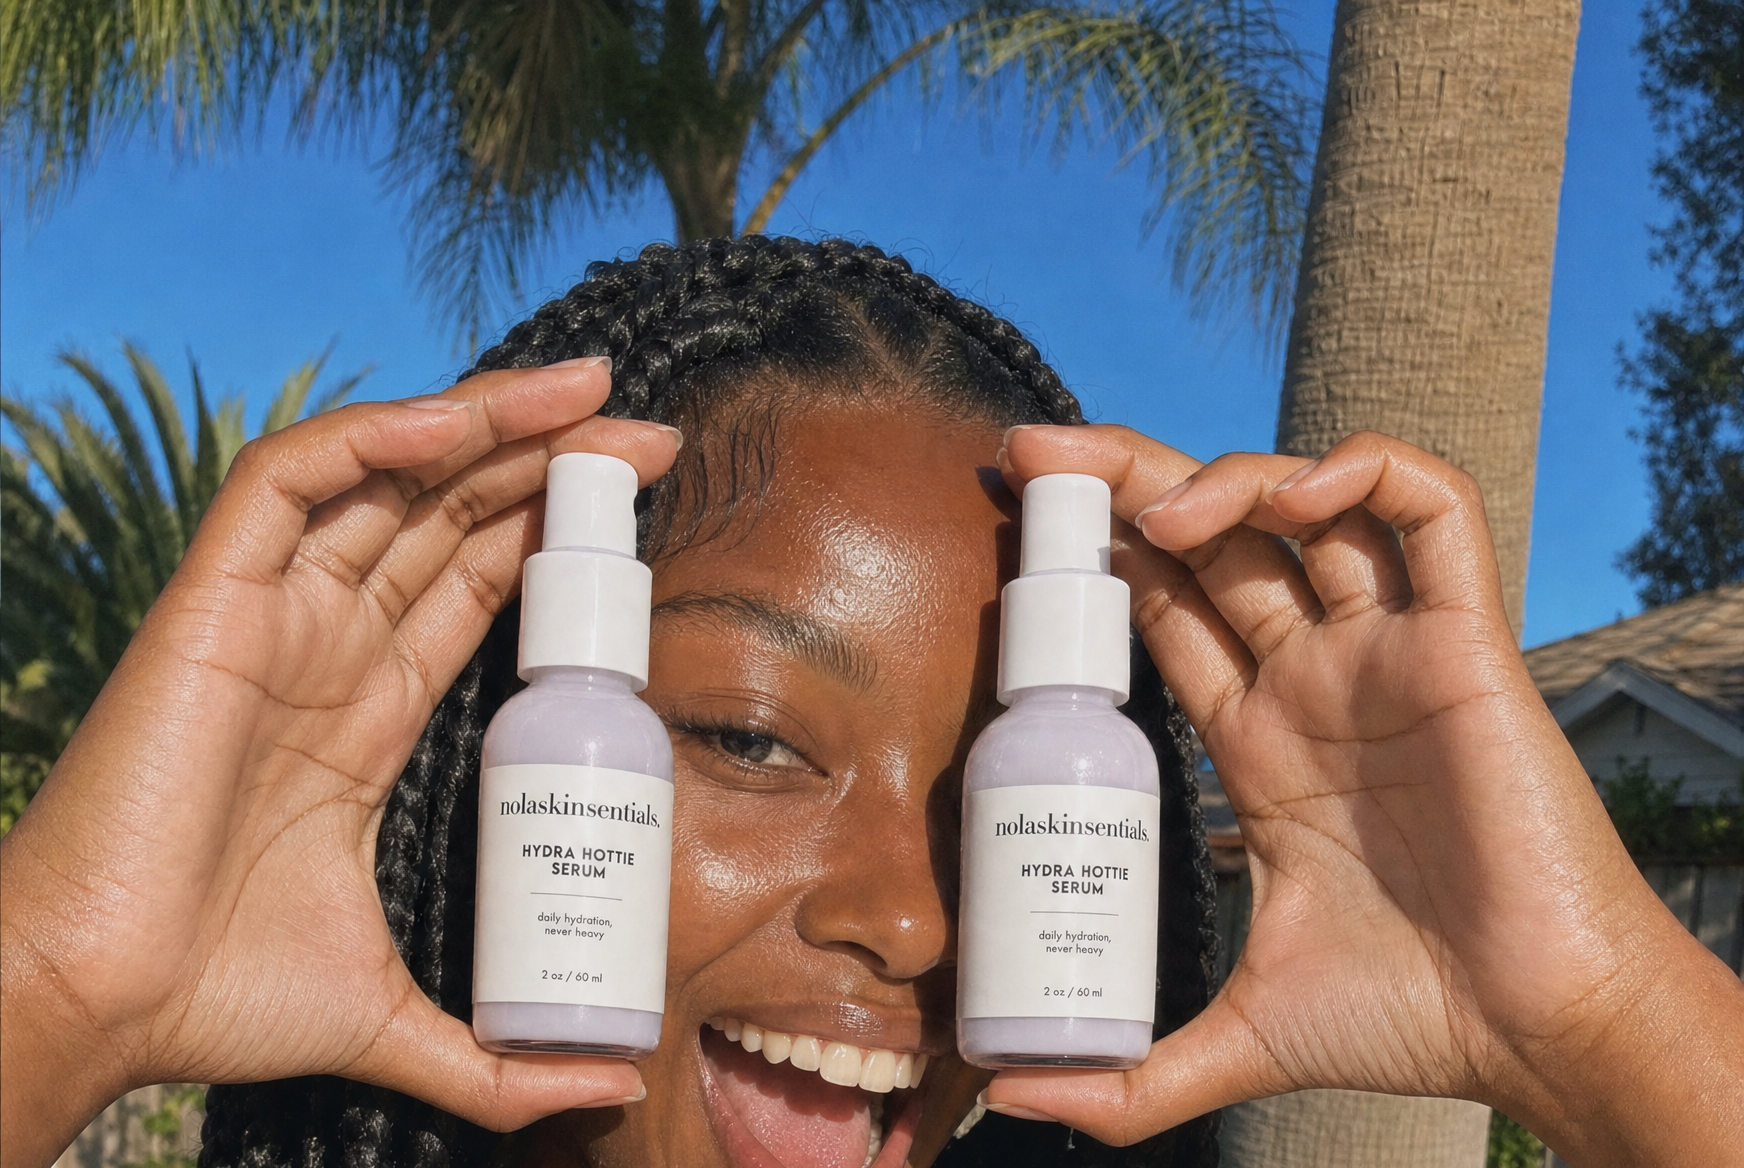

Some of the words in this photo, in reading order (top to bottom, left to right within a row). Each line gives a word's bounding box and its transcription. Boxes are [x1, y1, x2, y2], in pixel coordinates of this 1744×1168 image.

[500, 793, 659, 828] nolaskinsentials.
[995, 813, 1149, 841] nolaskinsentials.
[523, 845, 575, 859] HYDRA
[583, 848, 634, 867] HOTTIE
[552, 862, 605, 879] SERUM
[1022, 864, 1074, 877] HYDRA
[1082, 865, 1128, 880] HOTTIE
[1052, 881, 1103, 895] SERUM
[538, 912, 561, 924] daily
[565, 913, 612, 929] hydration,
[545, 928, 572, 936] never
[576, 927, 604, 941] heavy
[1039, 930, 1062, 942] daily
[1066, 930, 1111, 943] hydration,
[1046, 946, 1073, 954] never
[1076, 944, 1103, 957] heavy
[541, 970, 548, 980] 2
[566, 971, 572, 982] /
[576, 972, 590, 982] 60
[592, 974, 603, 983] ml
[1043, 987, 1051, 997] 2
[1068, 987, 1074, 998] /
[1077, 988, 1090, 998] 60
[1092, 988, 1103, 998] ml
